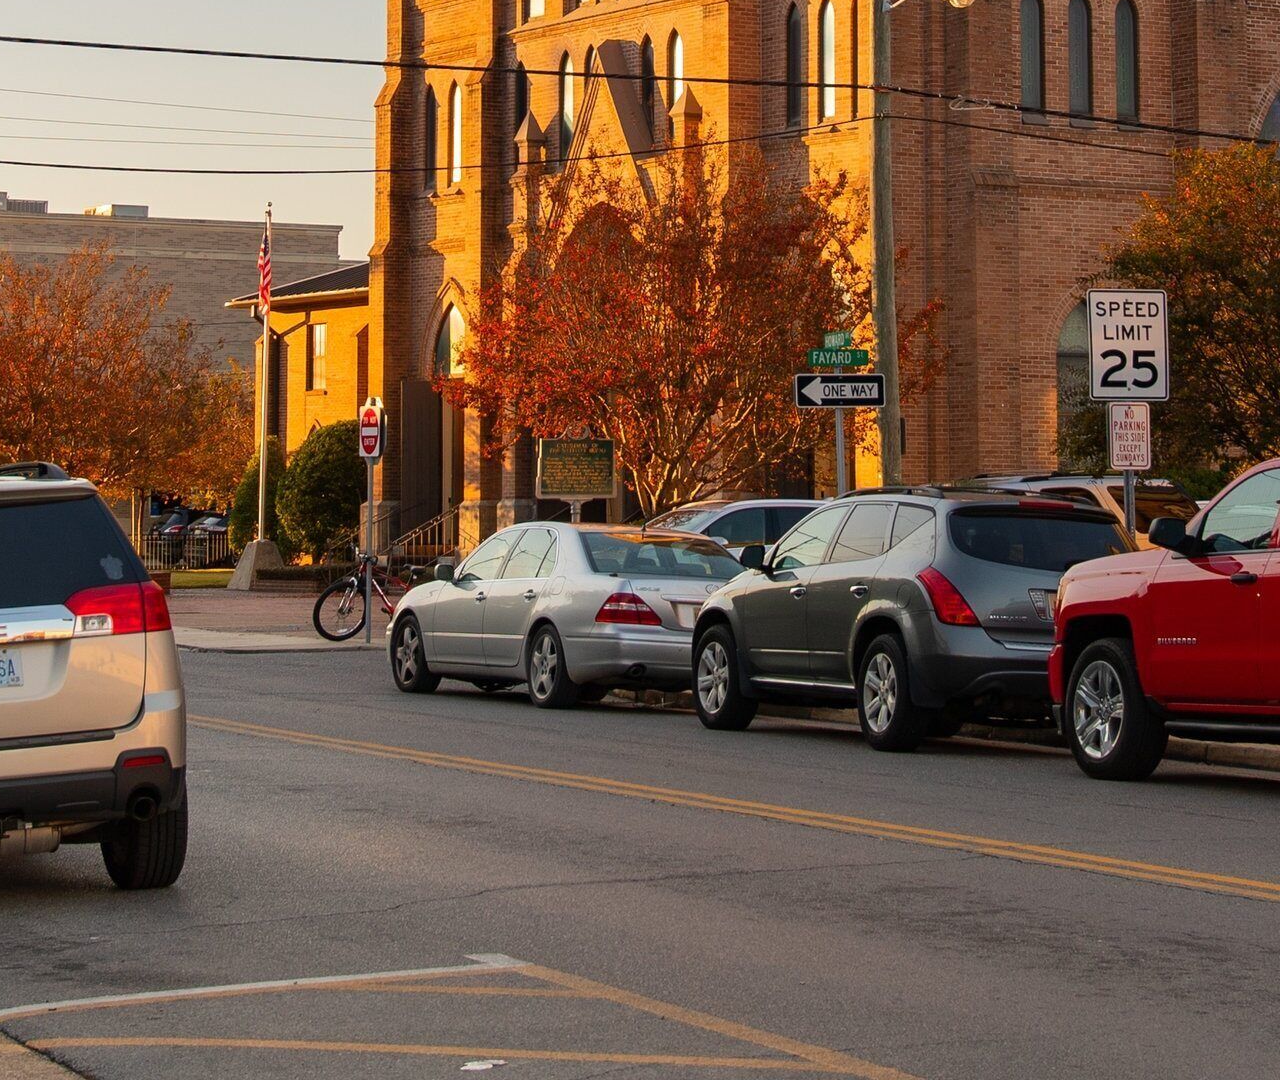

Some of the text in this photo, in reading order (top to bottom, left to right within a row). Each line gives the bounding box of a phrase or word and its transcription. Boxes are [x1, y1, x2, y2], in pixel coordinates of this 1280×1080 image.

[1095, 301, 1160, 317] SPEED
[1103, 325, 1153, 340] LIMIT
[812, 351, 852, 364] FAYARD
[1100, 349, 1159, 388] 25
[823, 384, 875, 397] ONE WAY
[1124, 409, 1135, 419] NO
[1113, 421, 1146, 431] PARKING
[363, 437, 375, 446] ENTER
[1114, 432, 1145, 443] THIS SIDE
[1119, 443, 1141, 452] EXCEPT
[1115, 453, 1145, 462] SUNDAYS
